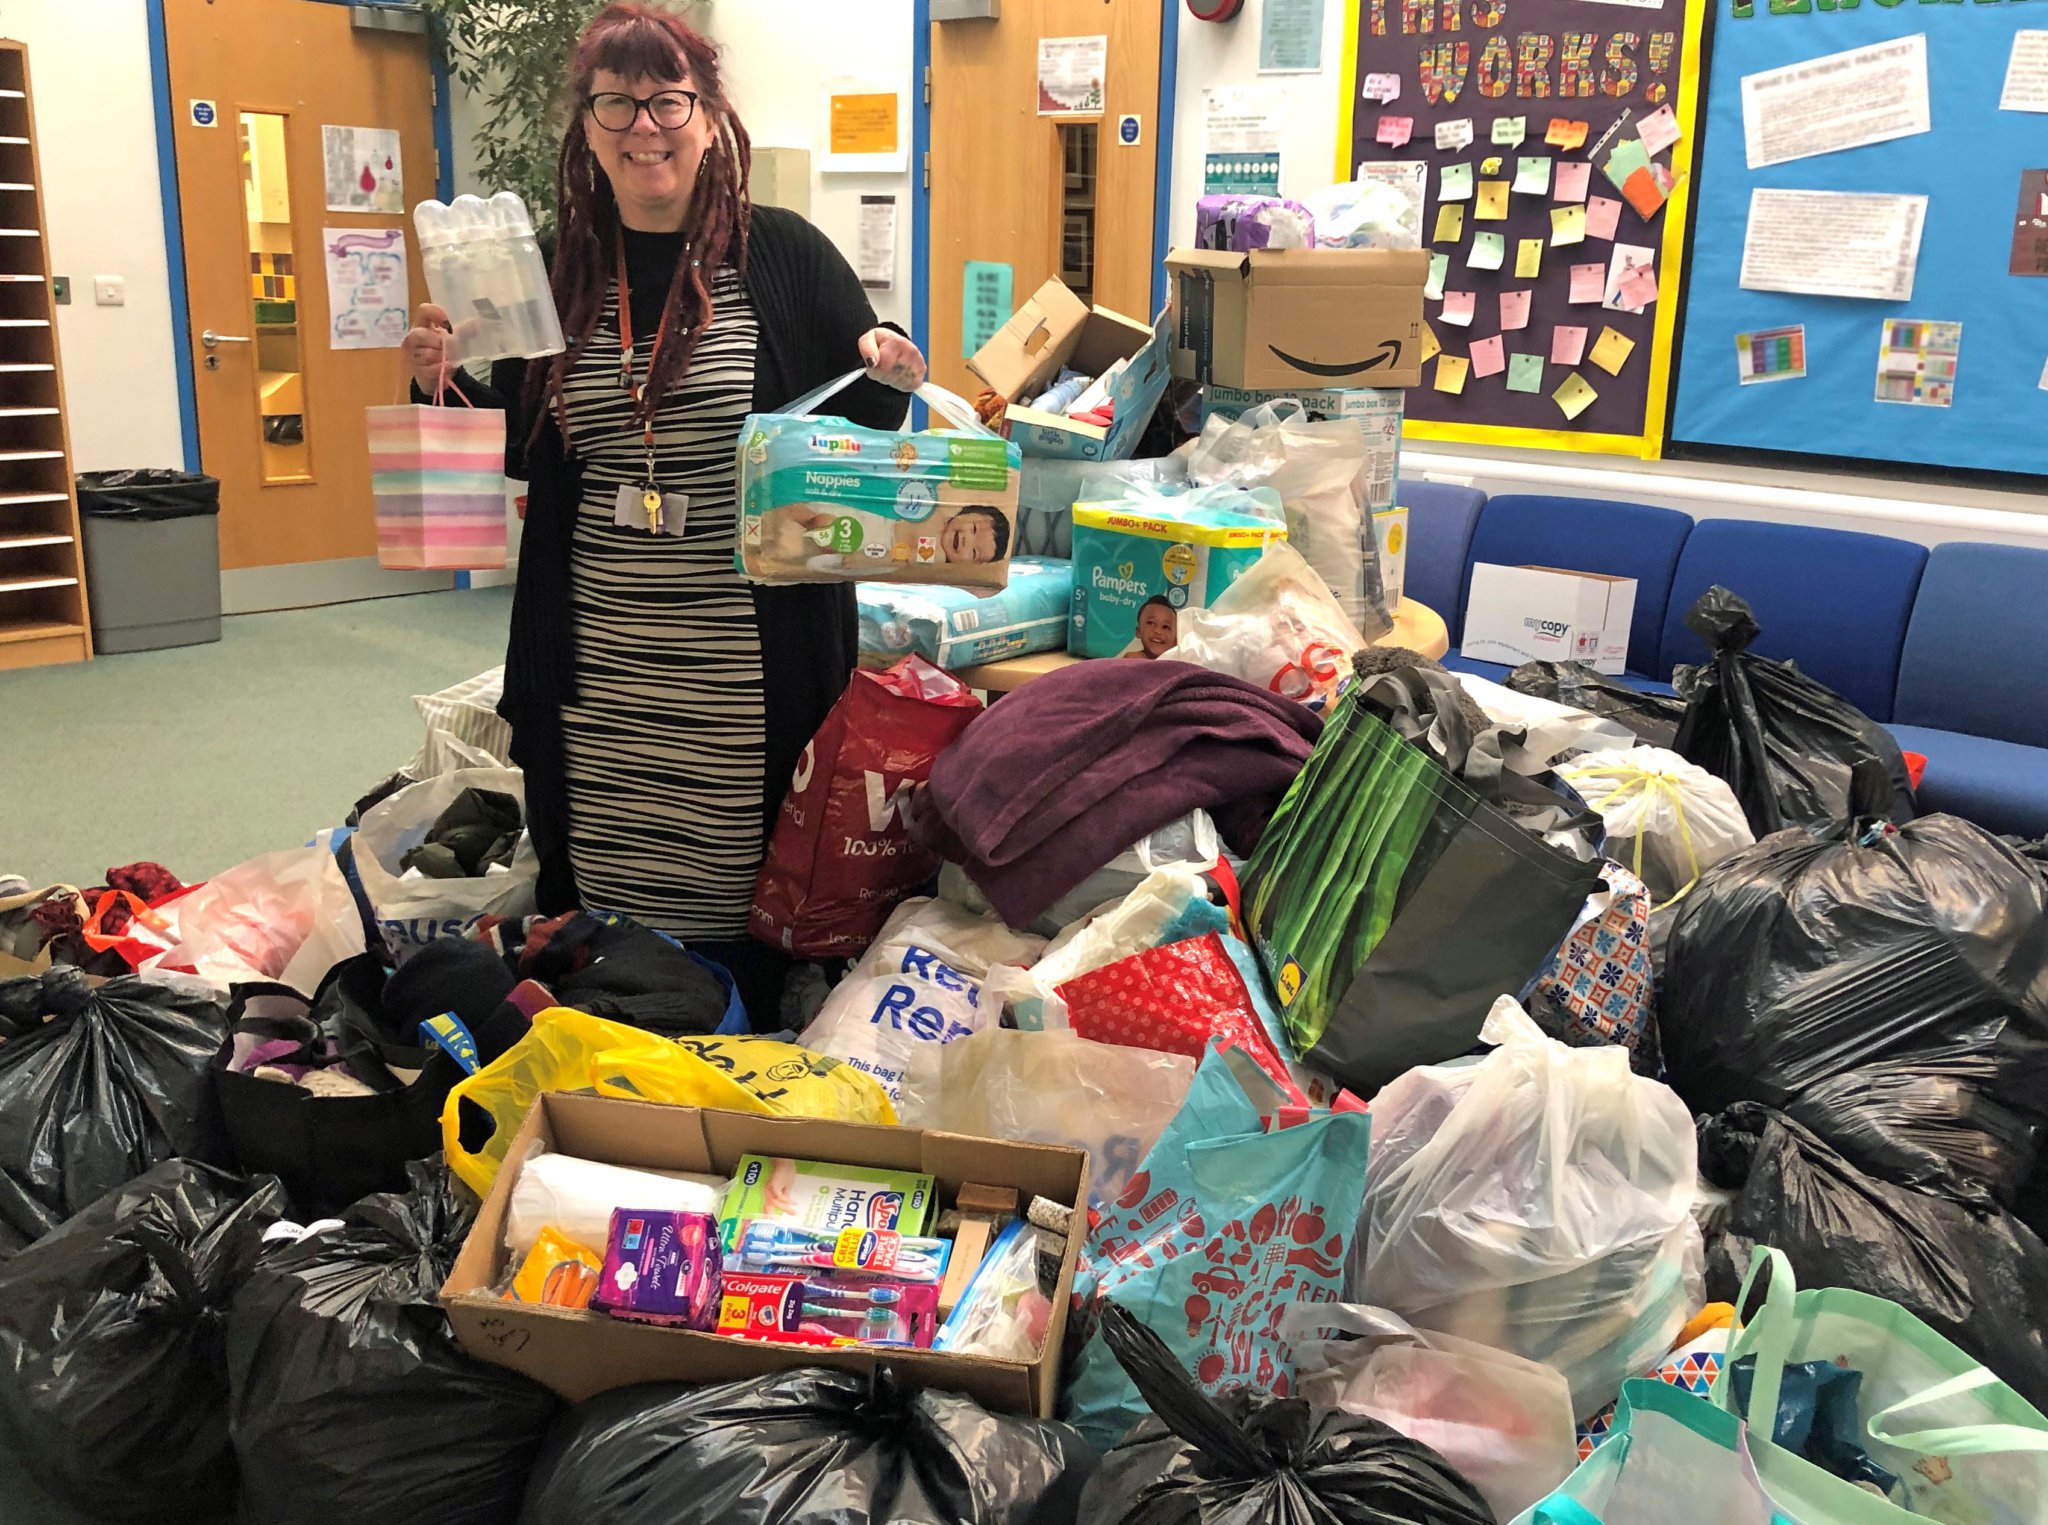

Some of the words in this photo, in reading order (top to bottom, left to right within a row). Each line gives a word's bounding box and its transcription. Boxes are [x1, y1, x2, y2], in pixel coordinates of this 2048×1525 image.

[1419, 31, 1676, 106] WORKS!
[1209, 388, 1252, 402] jumbo
[1301, 395, 1336, 410] pack
[811, 434, 862, 452] lupilu
[805, 470, 861, 489] Nappies
[839, 518, 852, 539] 3
[1106, 516, 1141, 530] JUMBO+
[1142, 520, 1168, 534] PACK
[1092, 565, 1147, 597] Pampers
[1099, 591, 1137, 609] baby-dry
[843, 836, 897, 856] 100%
[848, 1056, 871, 1072] This
[872, 1064, 896, 1083] bag
[836, 1230, 851, 1263] GREAT
[846, 1231, 861, 1264] VALUE
[873, 1234, 890, 1267] TRIPLE
[884, 1235, 899, 1268] PACK
[726, 1279, 783, 1296] Colgate
[724, 1302, 734, 1325] PACK
[731, 1308, 746, 1320] 3
